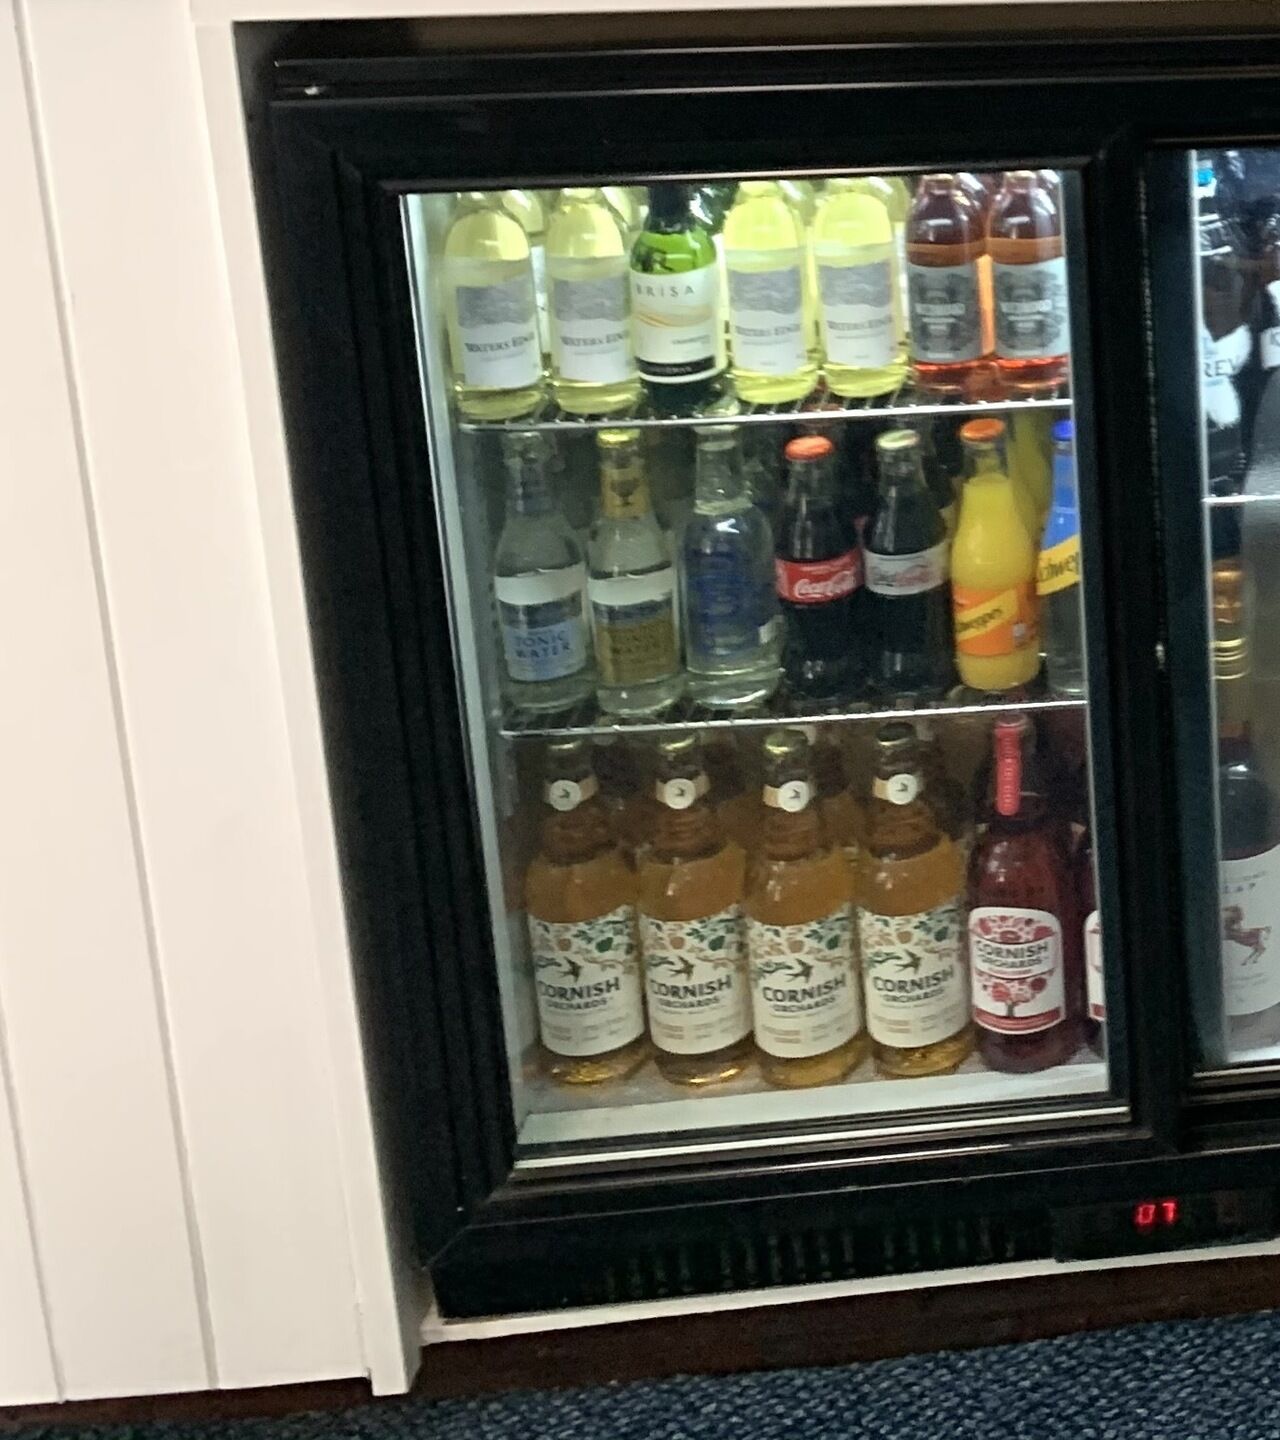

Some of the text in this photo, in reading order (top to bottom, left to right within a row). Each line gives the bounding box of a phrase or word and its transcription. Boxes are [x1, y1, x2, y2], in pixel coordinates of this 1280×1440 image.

[975, 940, 1049, 959] CORNISH
[651, 975, 732, 1000] CORNISH
[762, 974, 847, 1003] CORNISH
[873, 966, 956, 994] CORNISH
